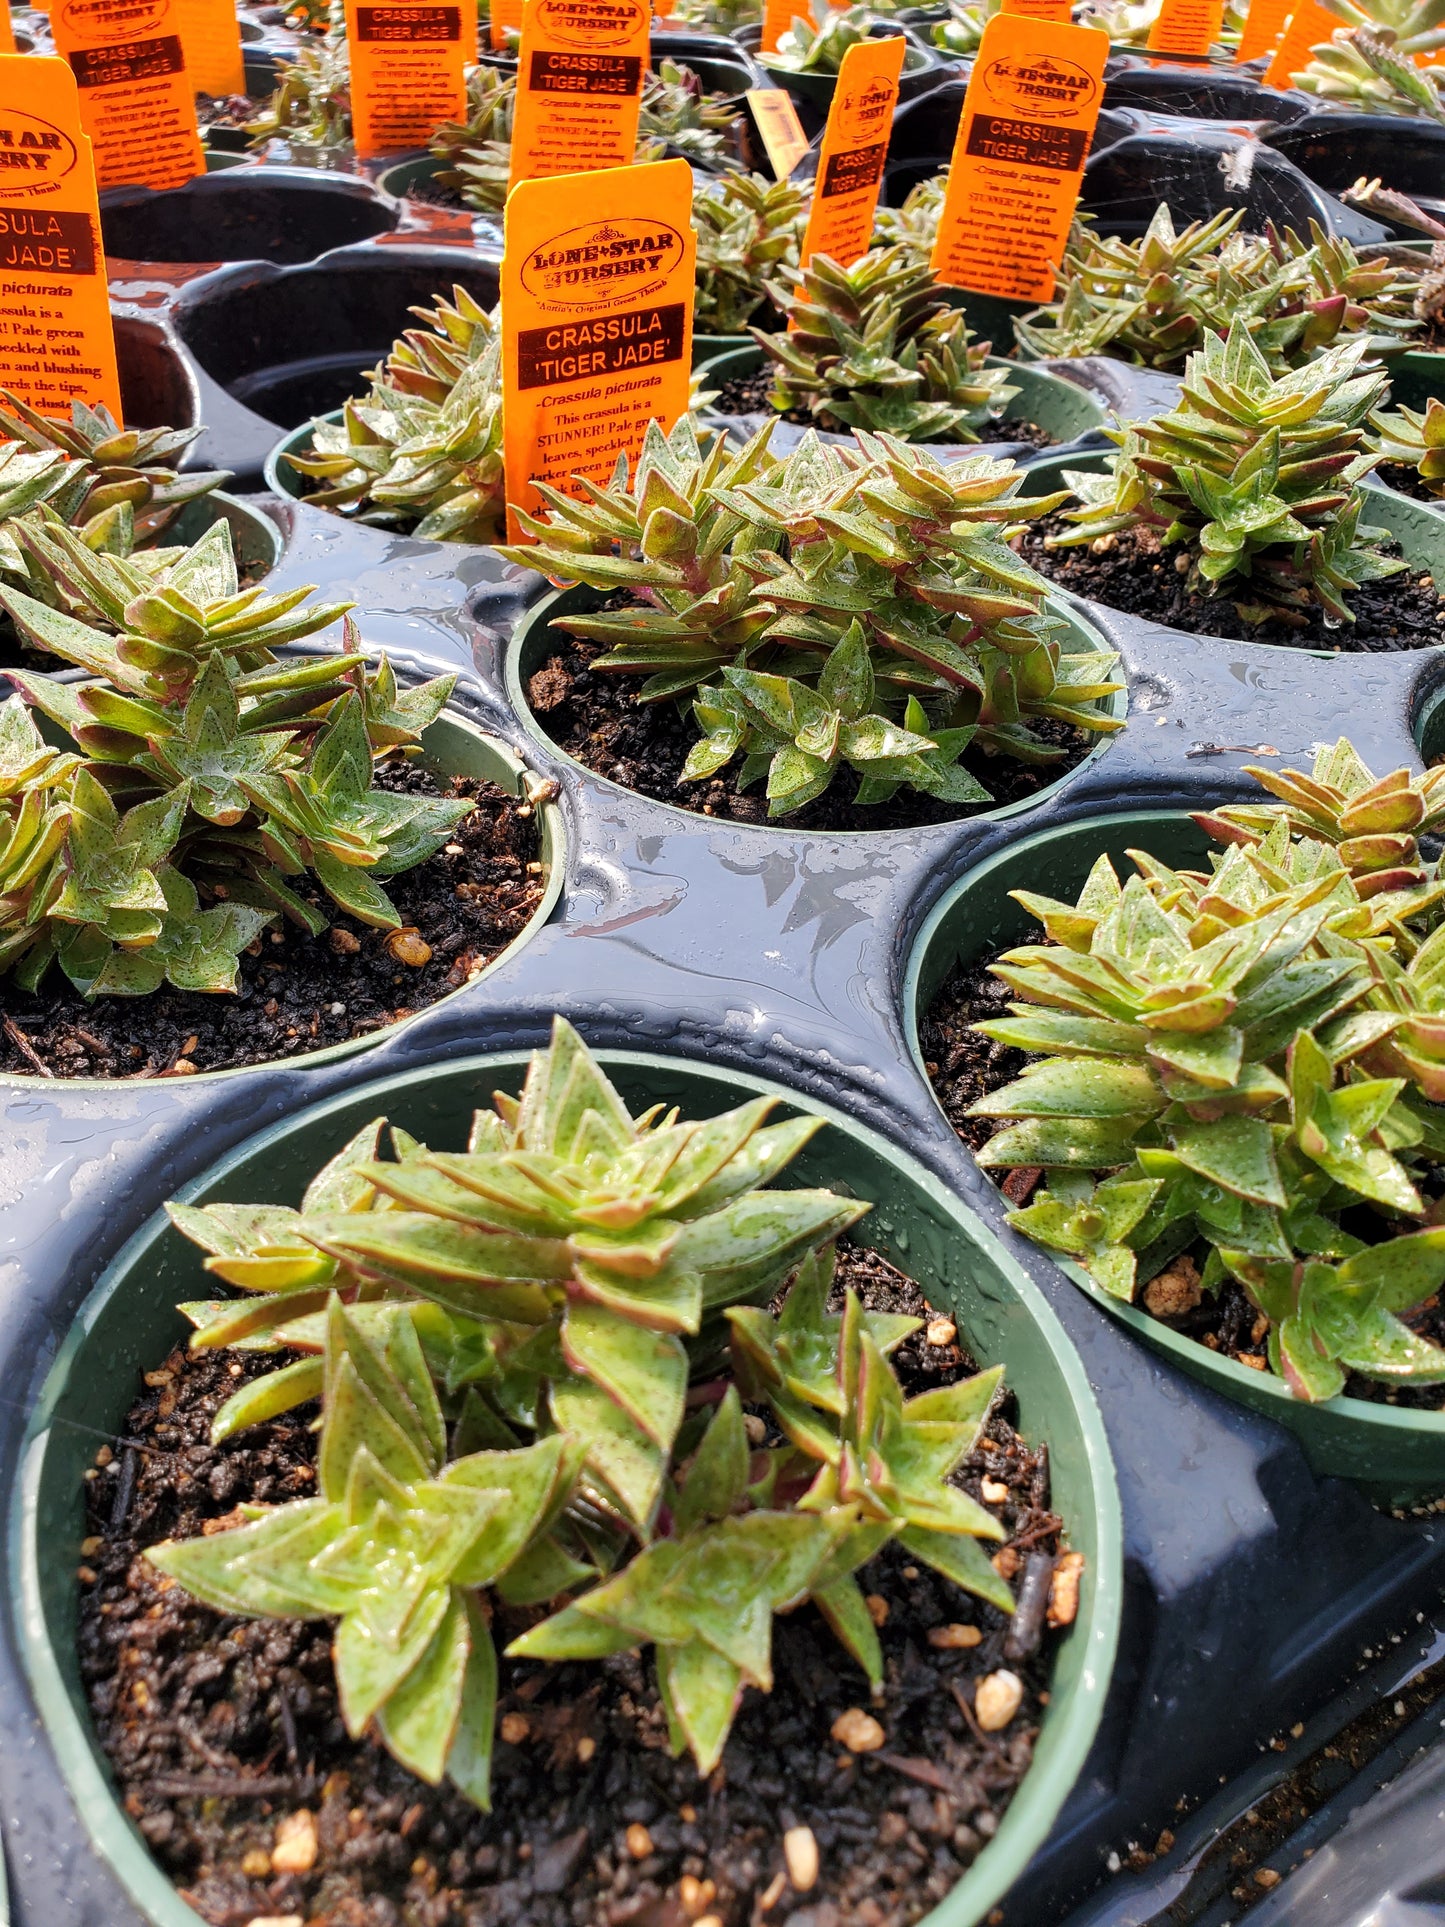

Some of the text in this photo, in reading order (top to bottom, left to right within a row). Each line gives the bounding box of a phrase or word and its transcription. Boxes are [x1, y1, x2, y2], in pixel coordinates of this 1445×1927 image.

[372, 9, 447, 22] CRASSULA
[85, 41, 164, 65] CRASSULA
[548, 55, 626, 72] CRASSULA
[990, 120, 1071, 145] CRASSULA
[0, 212, 64, 238] SULA
[6, 245, 77, 269] JADE'
[532, 232, 674, 271] LONE STAR
[543, 253, 664, 290] NURSERY
[2, 281, 73, 298] picturata
[613, 294, 637, 307] Green
[0, 304, 64, 320] ssula is a
[12, 322, 44, 338] Pale
[46, 328, 85, 342] green
[546, 313, 662, 350] CRASSULA
[50, 344, 81, 357] with
[534, 337, 671, 381] 'TIGER JADE'
[14, 361, 40, 373] and
[43, 361, 103, 380] blushing
[34, 379, 57, 392] the
[59, 381, 88, 397] tips,
[536, 375, 663, 410] -Crassula picturata
[554, 399, 652, 427] This crassula is a
[537, 422, 605, 450] STUNNER!
[608, 419, 633, 436] Pale
[542, 451, 583, 465] leaves,
[585, 435, 634, 458] speckled
[528, 469, 568, 483] darker
[570, 460, 602, 477] green
